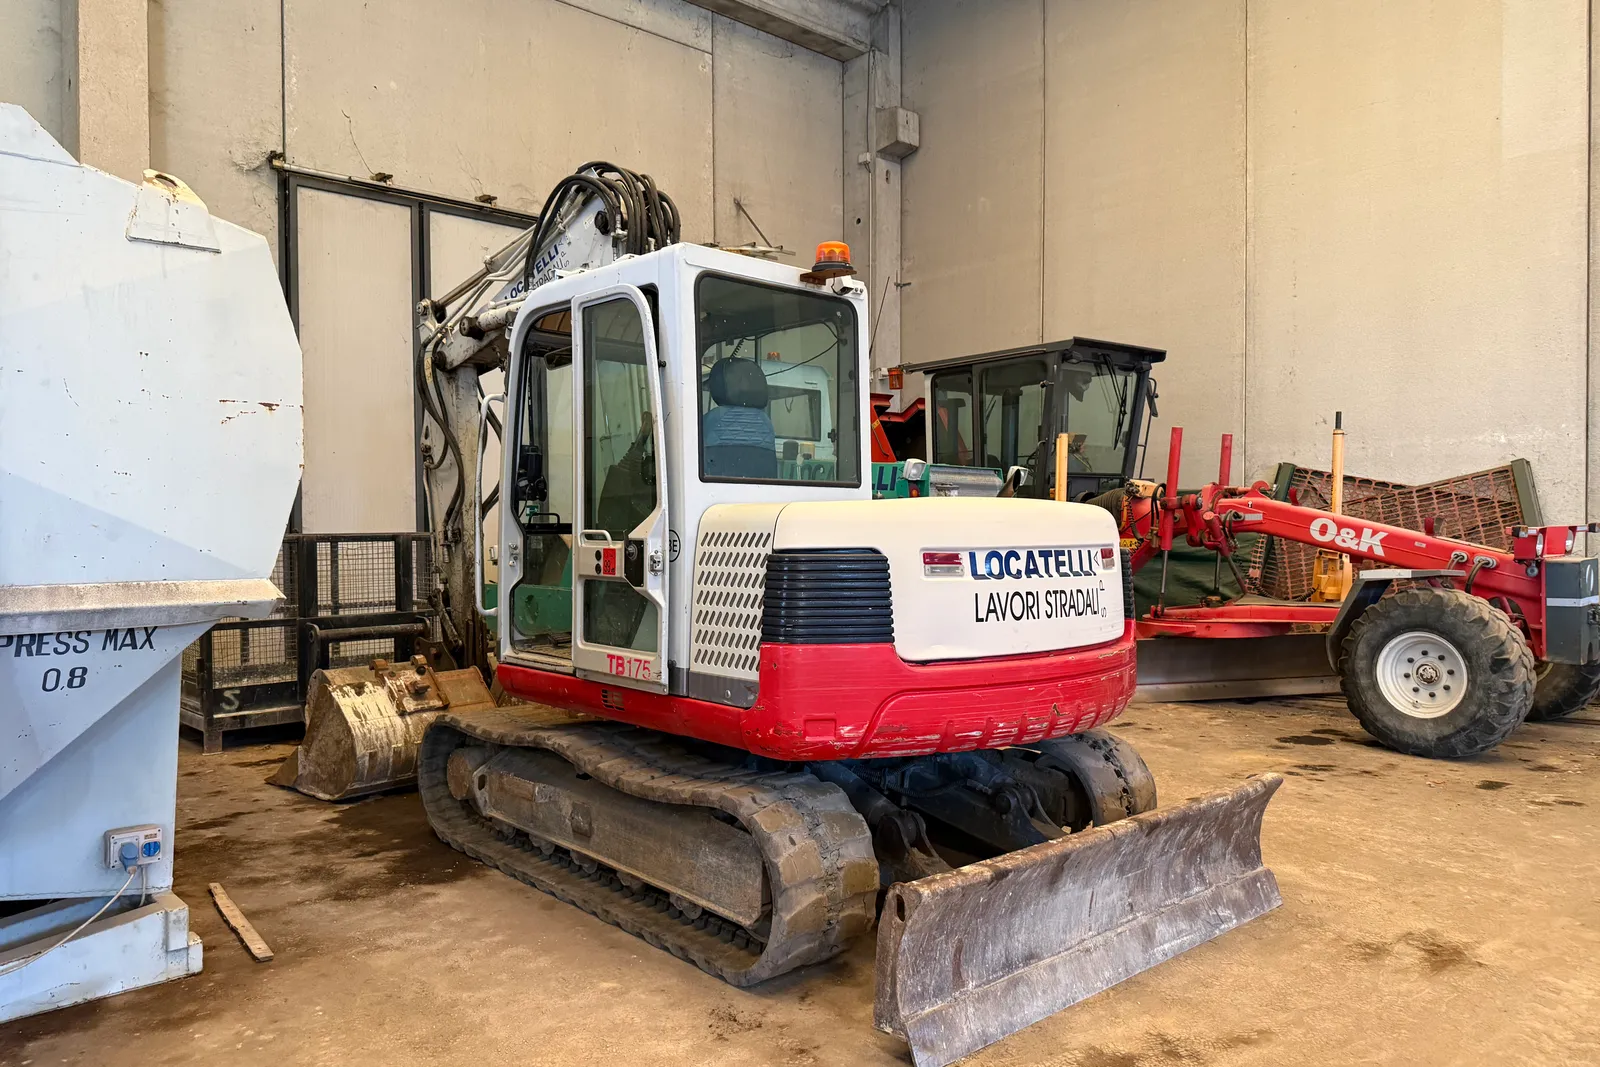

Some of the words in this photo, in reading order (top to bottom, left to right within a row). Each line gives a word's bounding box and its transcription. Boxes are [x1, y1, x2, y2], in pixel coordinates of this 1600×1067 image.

[1309, 517, 1389, 557] O&K
[968, 550, 1097, 580] LOCATELLI
[974, 590, 1040, 623] LAVORI
[1045, 588, 1100, 619] STRADALI
[101, 626, 158, 651] MAX
[606, 653, 651, 680] TB175
